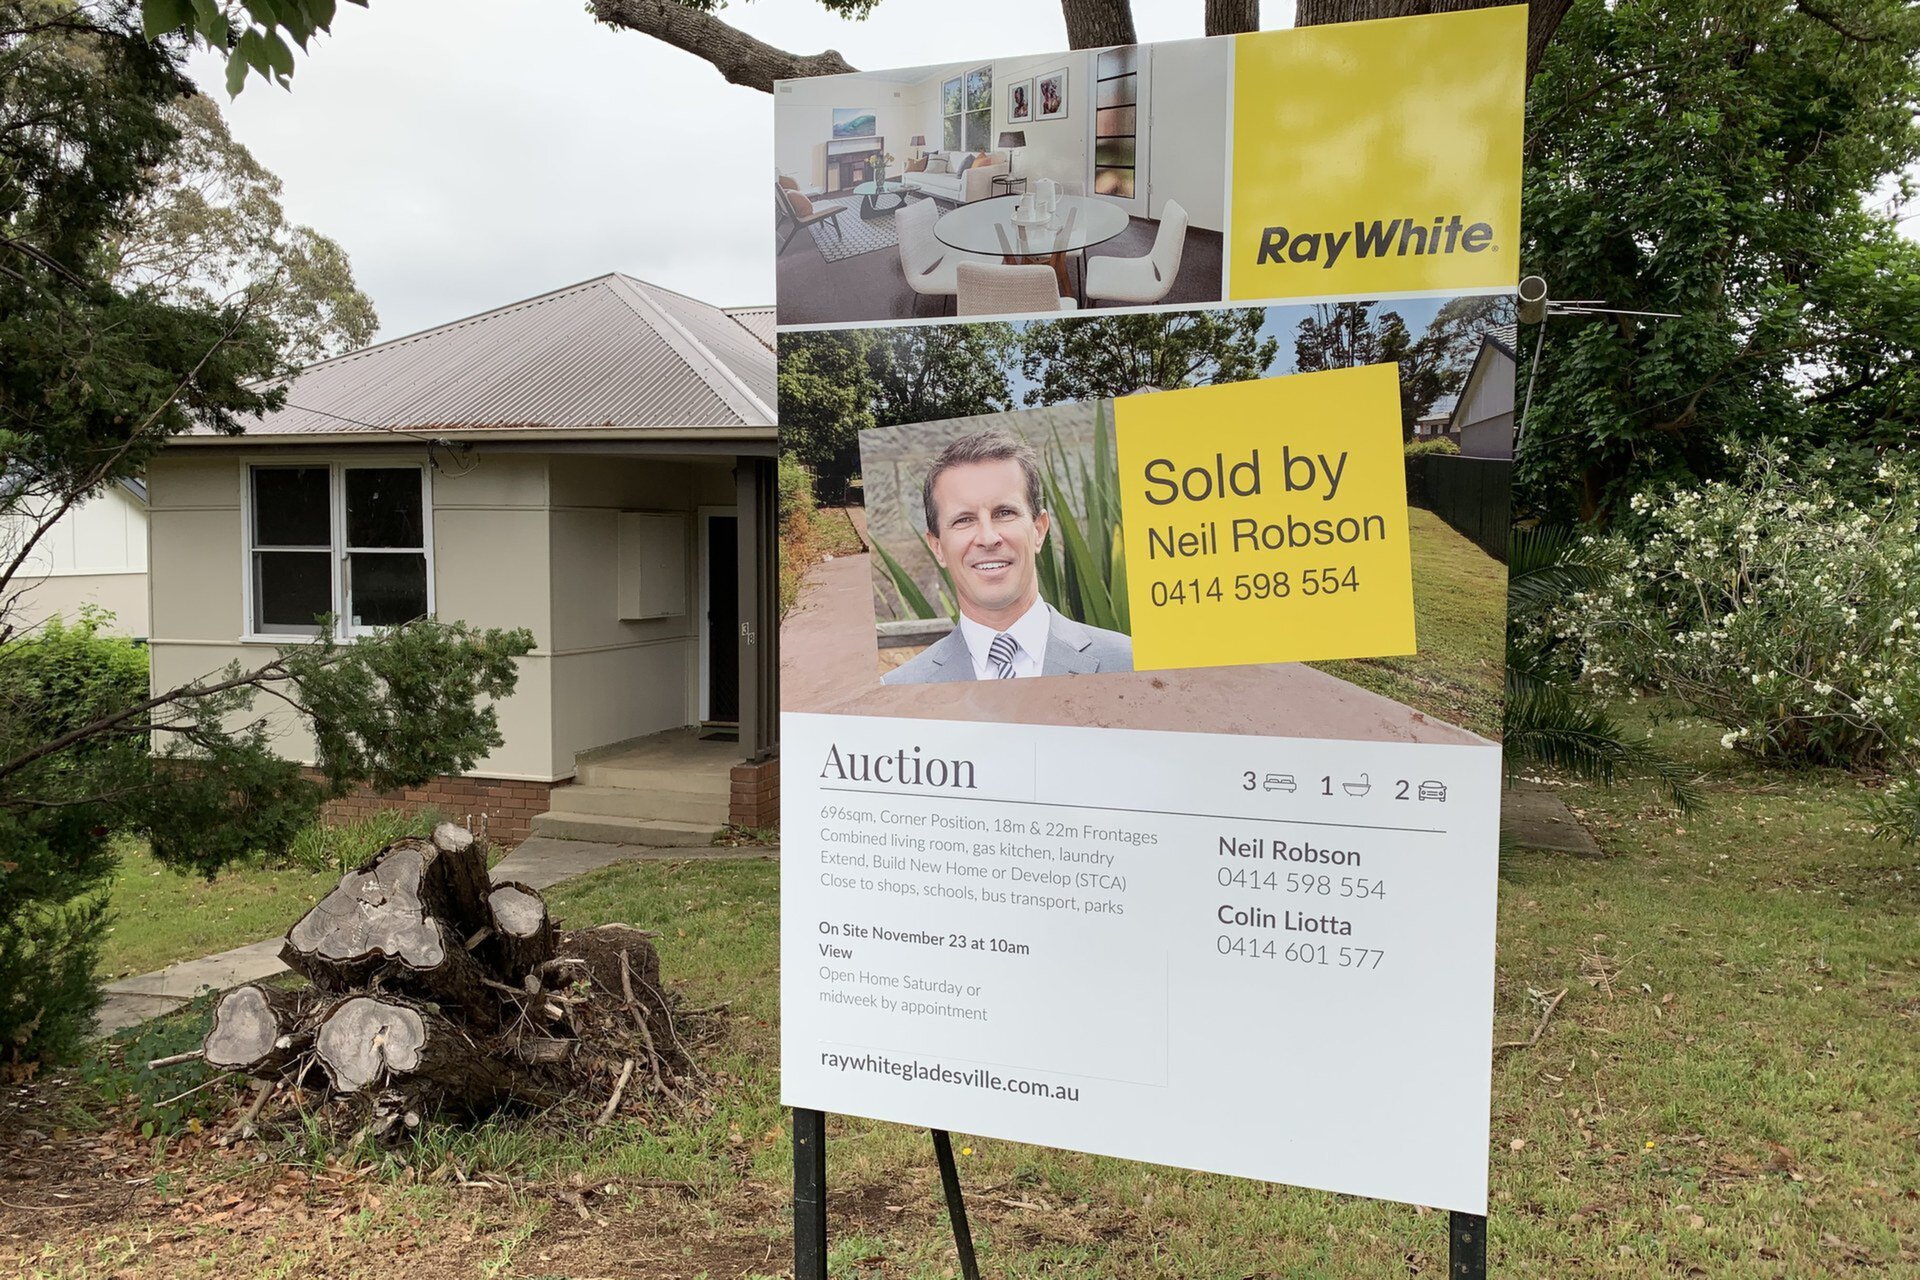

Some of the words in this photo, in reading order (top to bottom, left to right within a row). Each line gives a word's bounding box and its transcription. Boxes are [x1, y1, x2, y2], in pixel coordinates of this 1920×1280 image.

[1256, 216, 1493, 269] RayWhite
[1144, 448, 1261, 505] Sold
[1282, 446, 1348, 501] by
[1148, 522, 1217, 560] Neil
[1232, 514, 1386, 552] Robson
[1151, 576, 1223, 607] 0414
[1234, 571, 1290, 601] 598
[1301, 565, 1359, 596] 554
[819, 742, 977, 789] Auction
[1242, 771, 1256, 790] 3
[1321, 776, 1333, 796] 1
[1395, 780, 1410, 800] 2
[820, 805, 877, 824] 696sqm,
[880, 810, 926, 826] Corner
[930, 814, 989, 833] Position,
[994, 818, 1025, 835] 18m
[1030, 821, 1041, 835] &
[1046, 823, 1078, 838] 22m
[1083, 825, 1158, 847] Frontages
[820, 829, 887, 846] Combined
[891, 833, 926, 852] living
[929, 839, 969, 854] room,
[972, 842, 996, 857] gas
[1000, 841, 1055, 862] kitchen,
[1059, 847, 1114, 867] laundry
[1219, 836, 1264, 859] Neil
[1272, 840, 1360, 866] Robson
[820, 851, 869, 869] Extend,
[873, 854, 905, 871] Build
[910, 858, 942, 874] New
[946, 862, 988, 878] Home
[991, 866, 1007, 879] or
[1011, 867, 1071, 888] Develop
[1075, 874, 1127, 893] (STCA)
[1218, 867, 1278, 890] 0414
[1286, 872, 1331, 895] 598
[1340, 877, 1386, 900] 554
[820, 873, 856, 890] Close
[860, 878, 874, 890] to
[877, 878, 919, 897] shops,
[923, 883, 978, 901] schools,
[981, 887, 1007, 904] bus
[1010, 891, 1080, 912] transport,
[1084, 899, 1124, 916] parks
[1218, 904, 1276, 928] Colin
[1285, 910, 1352, 936] Liotta
[819, 921, 839, 936] On
[843, 924, 868, 939] Site
[872, 926, 945, 946] November
[949, 934, 967, 949] 23
[970, 937, 985, 951] at
[989, 938, 1030, 955] 10am
[819, 944, 852, 959] View
[1217, 935, 1277, 959] 0414
[1285, 942, 1329, 965] 601
[1338, 947, 1384, 970] 577
[819, 966, 855, 984] Open
[859, 971, 899, 988] Home
[903, 976, 963, 997] Saturday
[967, 985, 981, 996] or
[819, 989, 878, 1009] midweek
[881, 995, 897, 1012] by
[901, 1000, 988, 1021] appointment
[821, 1050, 1079, 1102] raywhitegladesville.com.au
